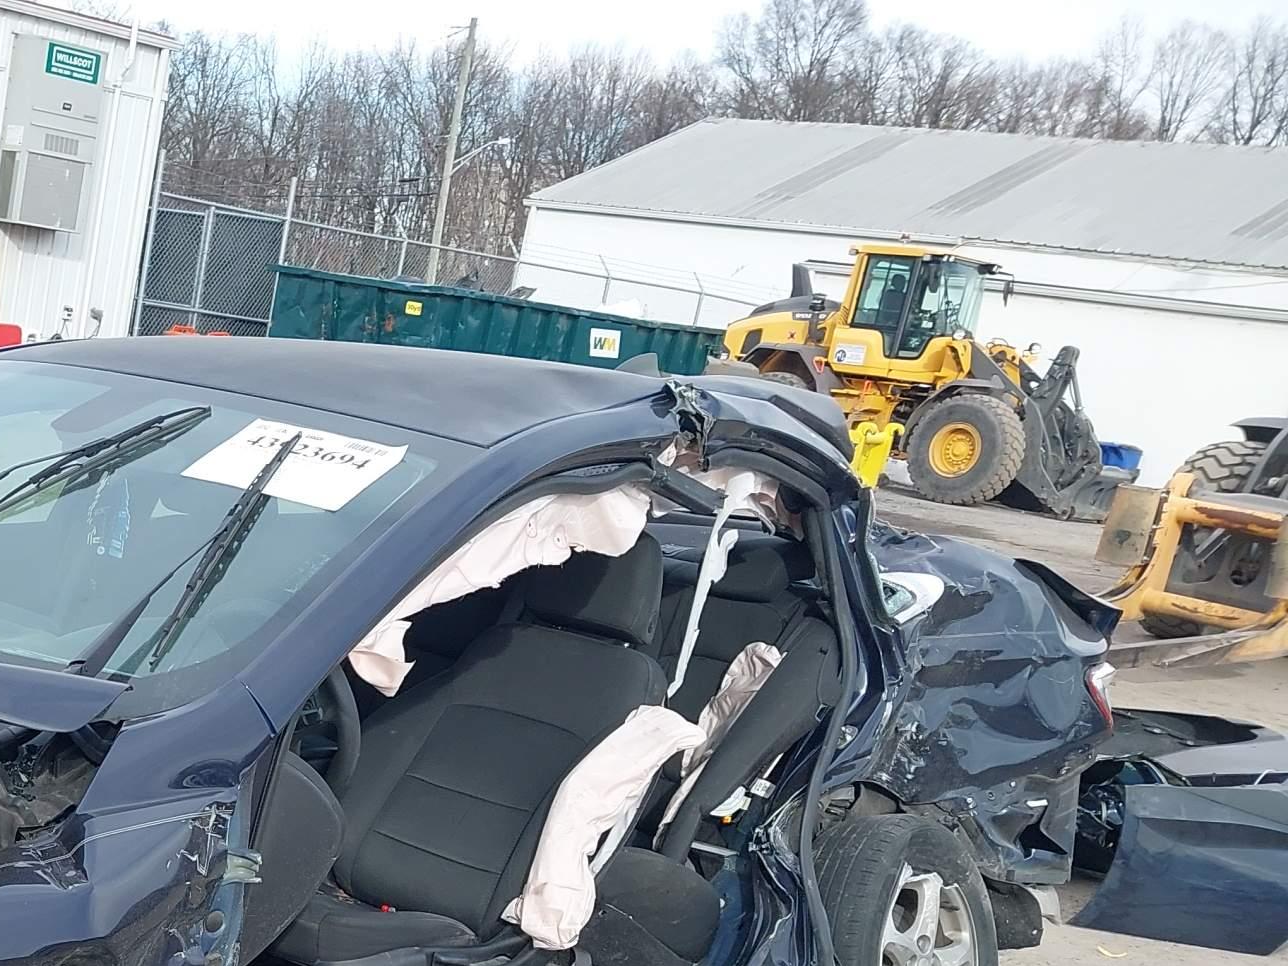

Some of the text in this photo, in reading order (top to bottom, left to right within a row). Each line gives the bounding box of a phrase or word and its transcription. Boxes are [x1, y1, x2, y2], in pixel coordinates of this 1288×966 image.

[55, 52, 92, 69] WILLSCOT
[593, 336, 616, 352] WM
[247, 435, 372, 470] 4323694
